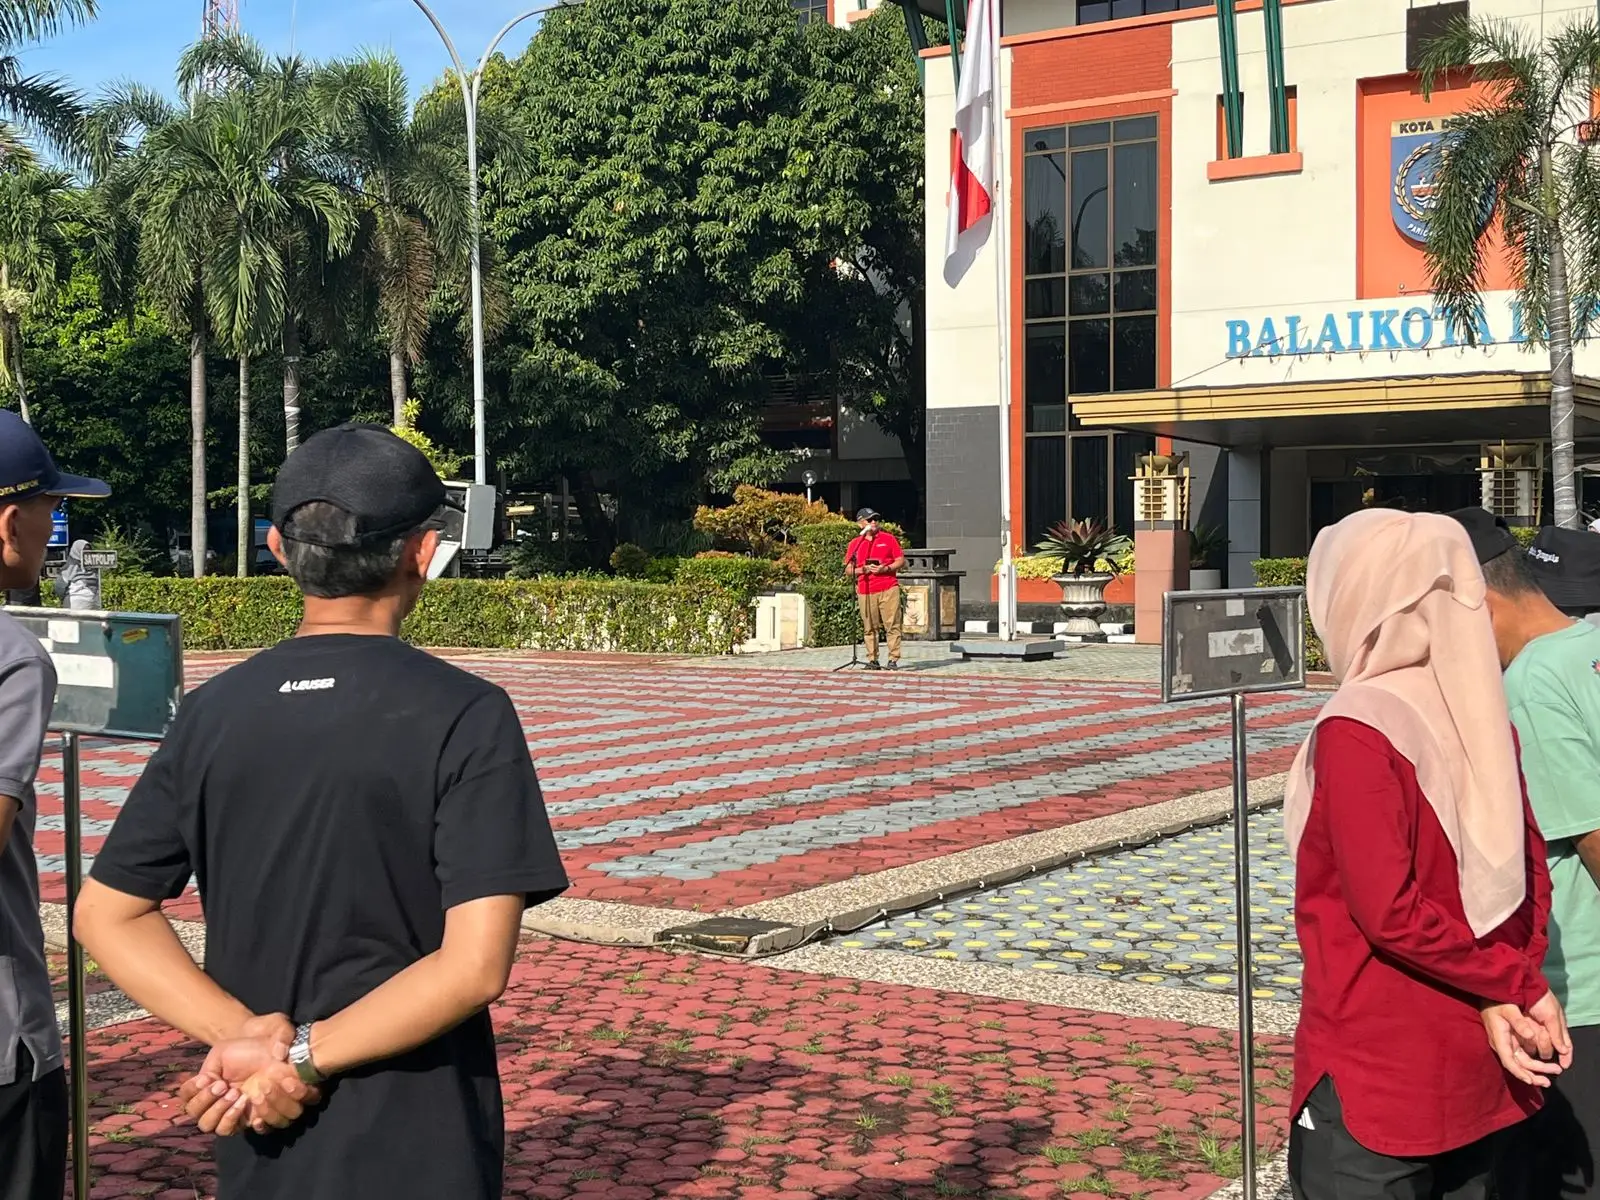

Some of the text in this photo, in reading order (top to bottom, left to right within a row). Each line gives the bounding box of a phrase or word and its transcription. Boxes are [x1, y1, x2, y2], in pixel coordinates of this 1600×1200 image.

[1400, 121, 1434, 134] KOTA
[1225, 304, 1496, 358] BALAIKOTA
[0, 486, 16, 496] OTA
